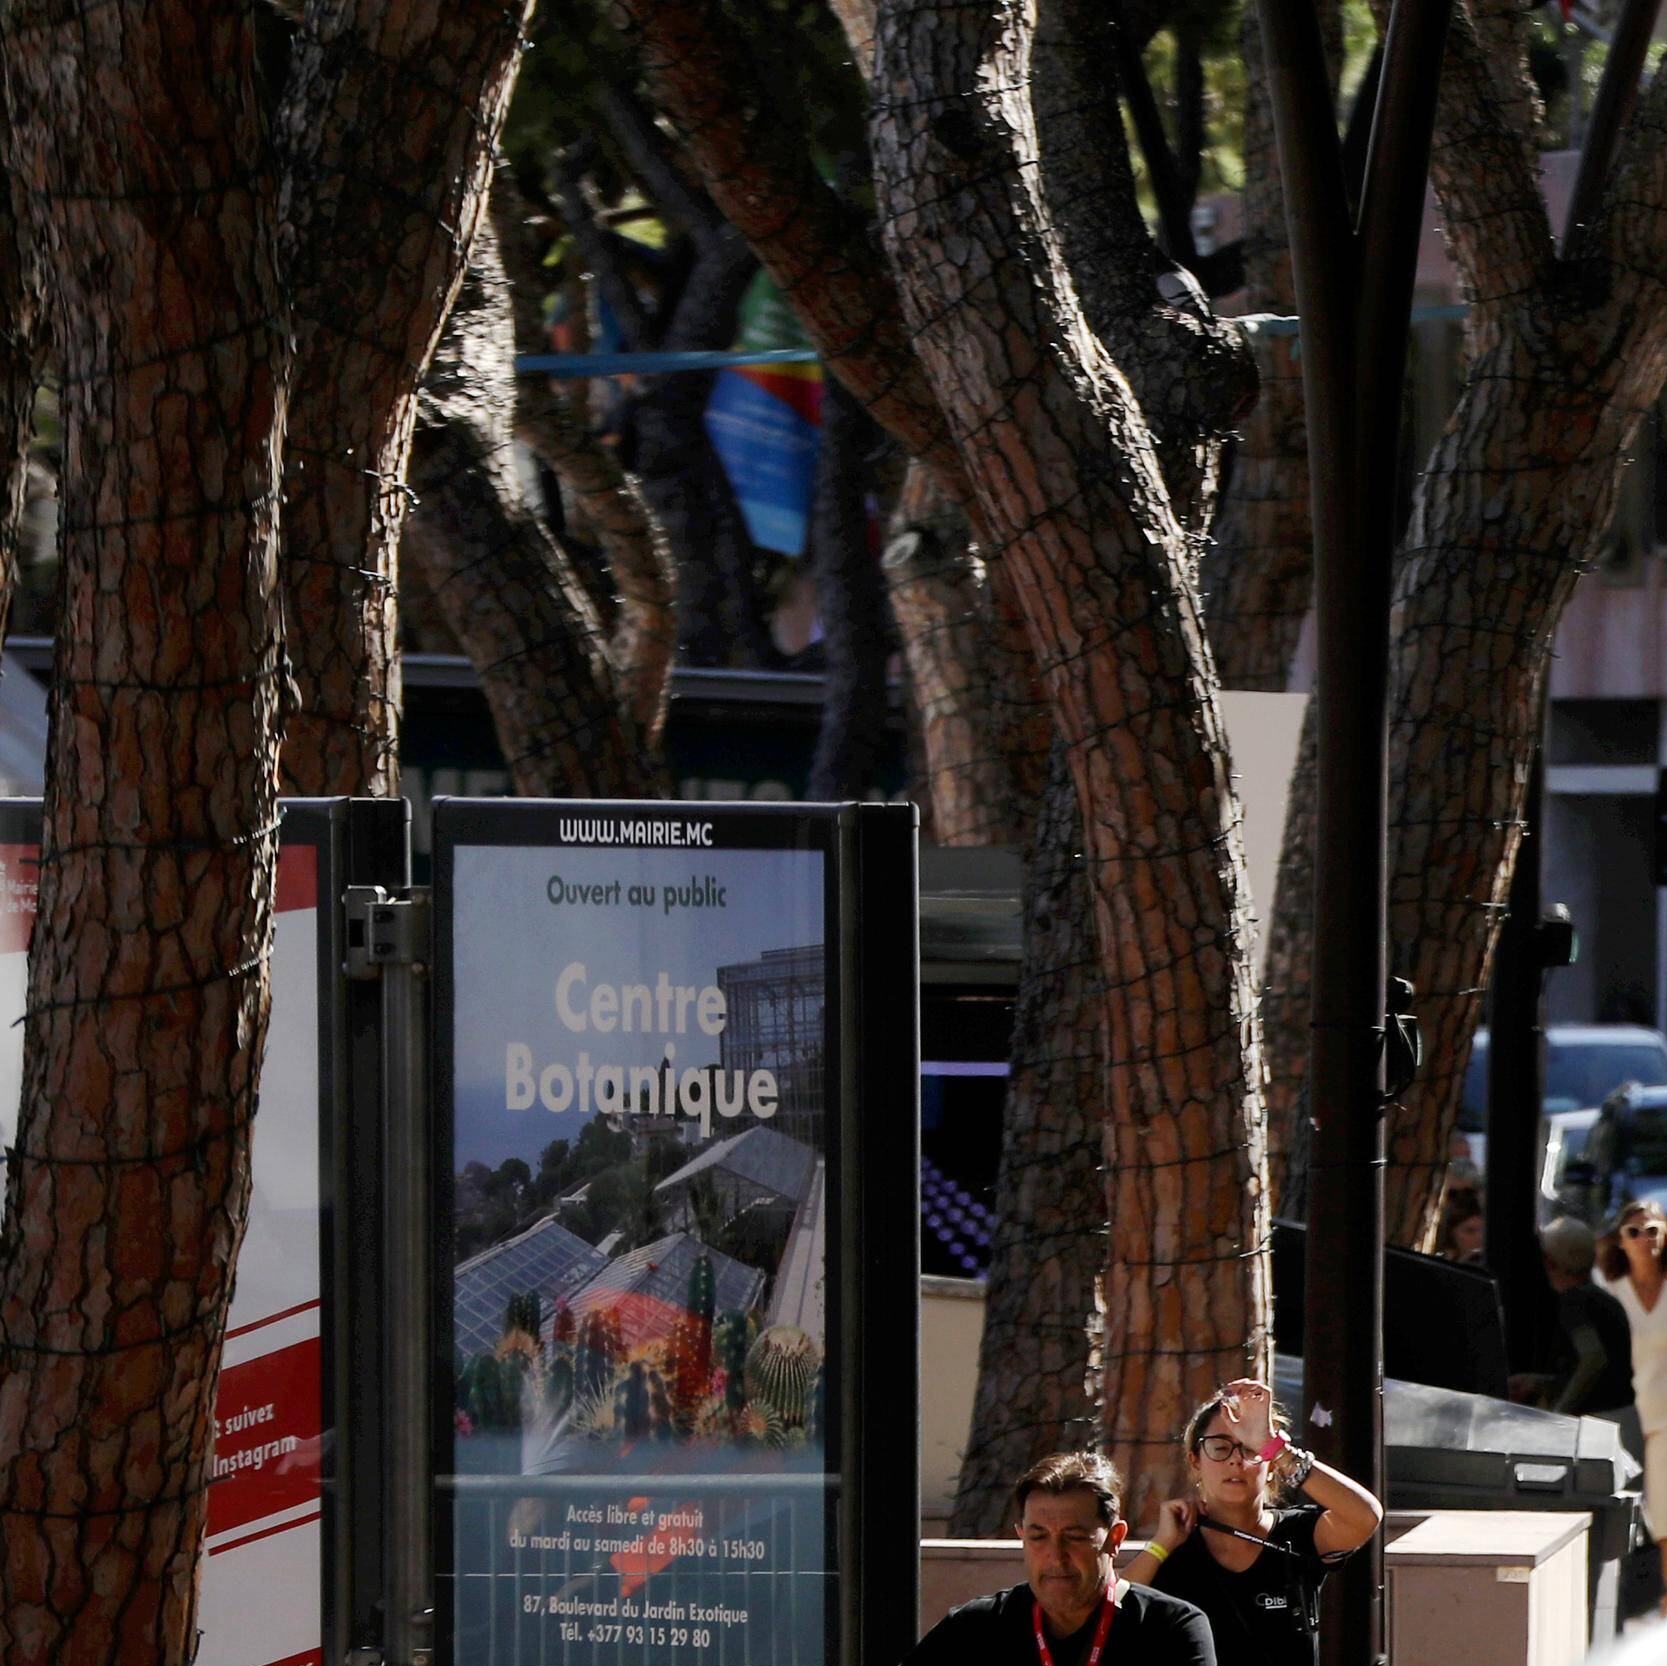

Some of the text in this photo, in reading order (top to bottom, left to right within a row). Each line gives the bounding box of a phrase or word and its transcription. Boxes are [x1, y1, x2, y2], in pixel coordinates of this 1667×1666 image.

[559, 818, 714, 848] WWW.MAIRIE.MC
[546, 874, 728, 914] Ouvert au public
[556, 962, 728, 1035] Centre
[505, 1042, 779, 1138] Botanique
[225, 1403, 275, 1435] suivez
[212, 1435, 297, 1477] Instagram
[566, 1504, 704, 1531] Accès libre et gratuit
[509, 1529, 765, 1560] du mardi au samedi de 8h30 à 15h30
[523, 1595, 748, 1628] 87, Boulevard du Jardin Exotique
[559, 1623, 710, 1648] Tél. +377 93 15 29 80
